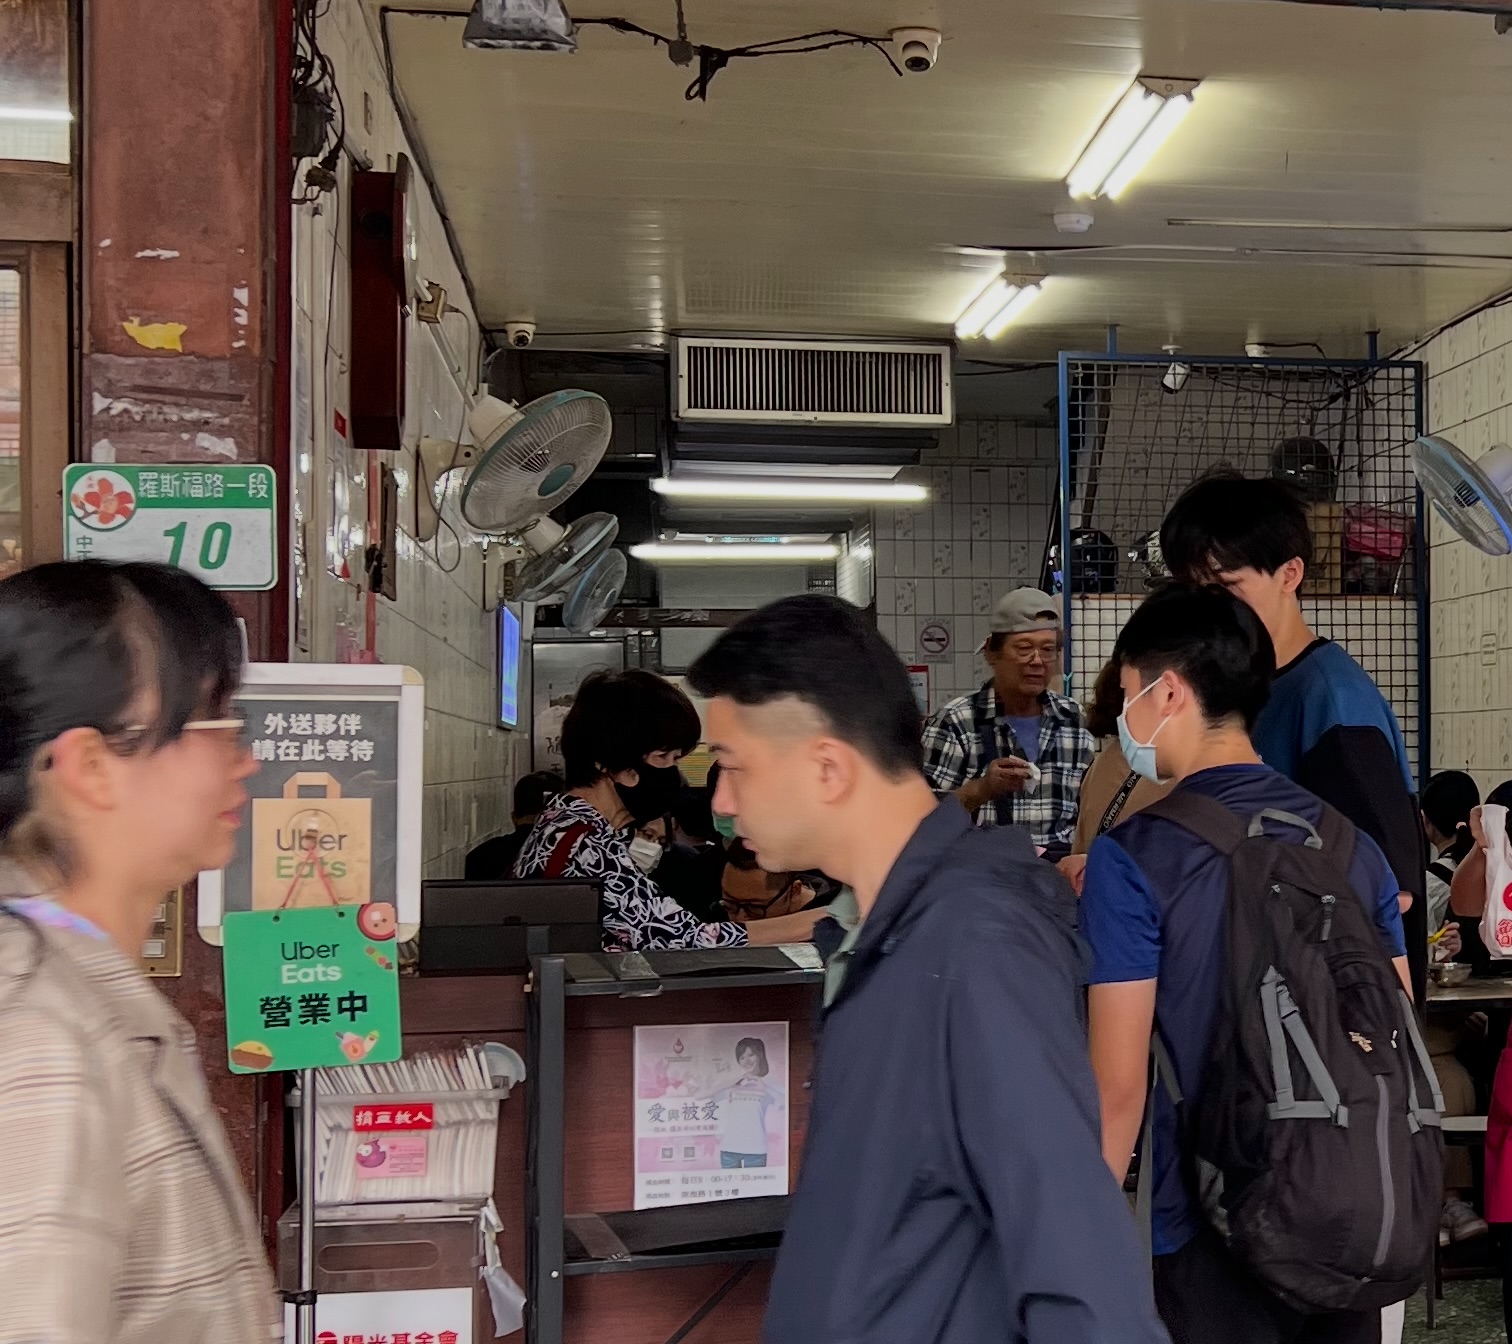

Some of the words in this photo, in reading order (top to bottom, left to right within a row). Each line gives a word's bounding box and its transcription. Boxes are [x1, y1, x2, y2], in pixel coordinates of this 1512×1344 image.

[137, 471, 270, 500] 羅斯福路一段
[162, 521, 233, 571] 10
[263, 712, 363, 736] 外送夥伴
[251, 738, 375, 762] 請在此等待
[276, 828, 348, 852] Uber
[275, 855, 348, 879] Eats
[280, 941, 341, 961] Uber
[280, 963, 342, 985] Eats
[259, 989, 369, 1030] 營業中
[647, 1101, 720, 1123] 愛與被愛
